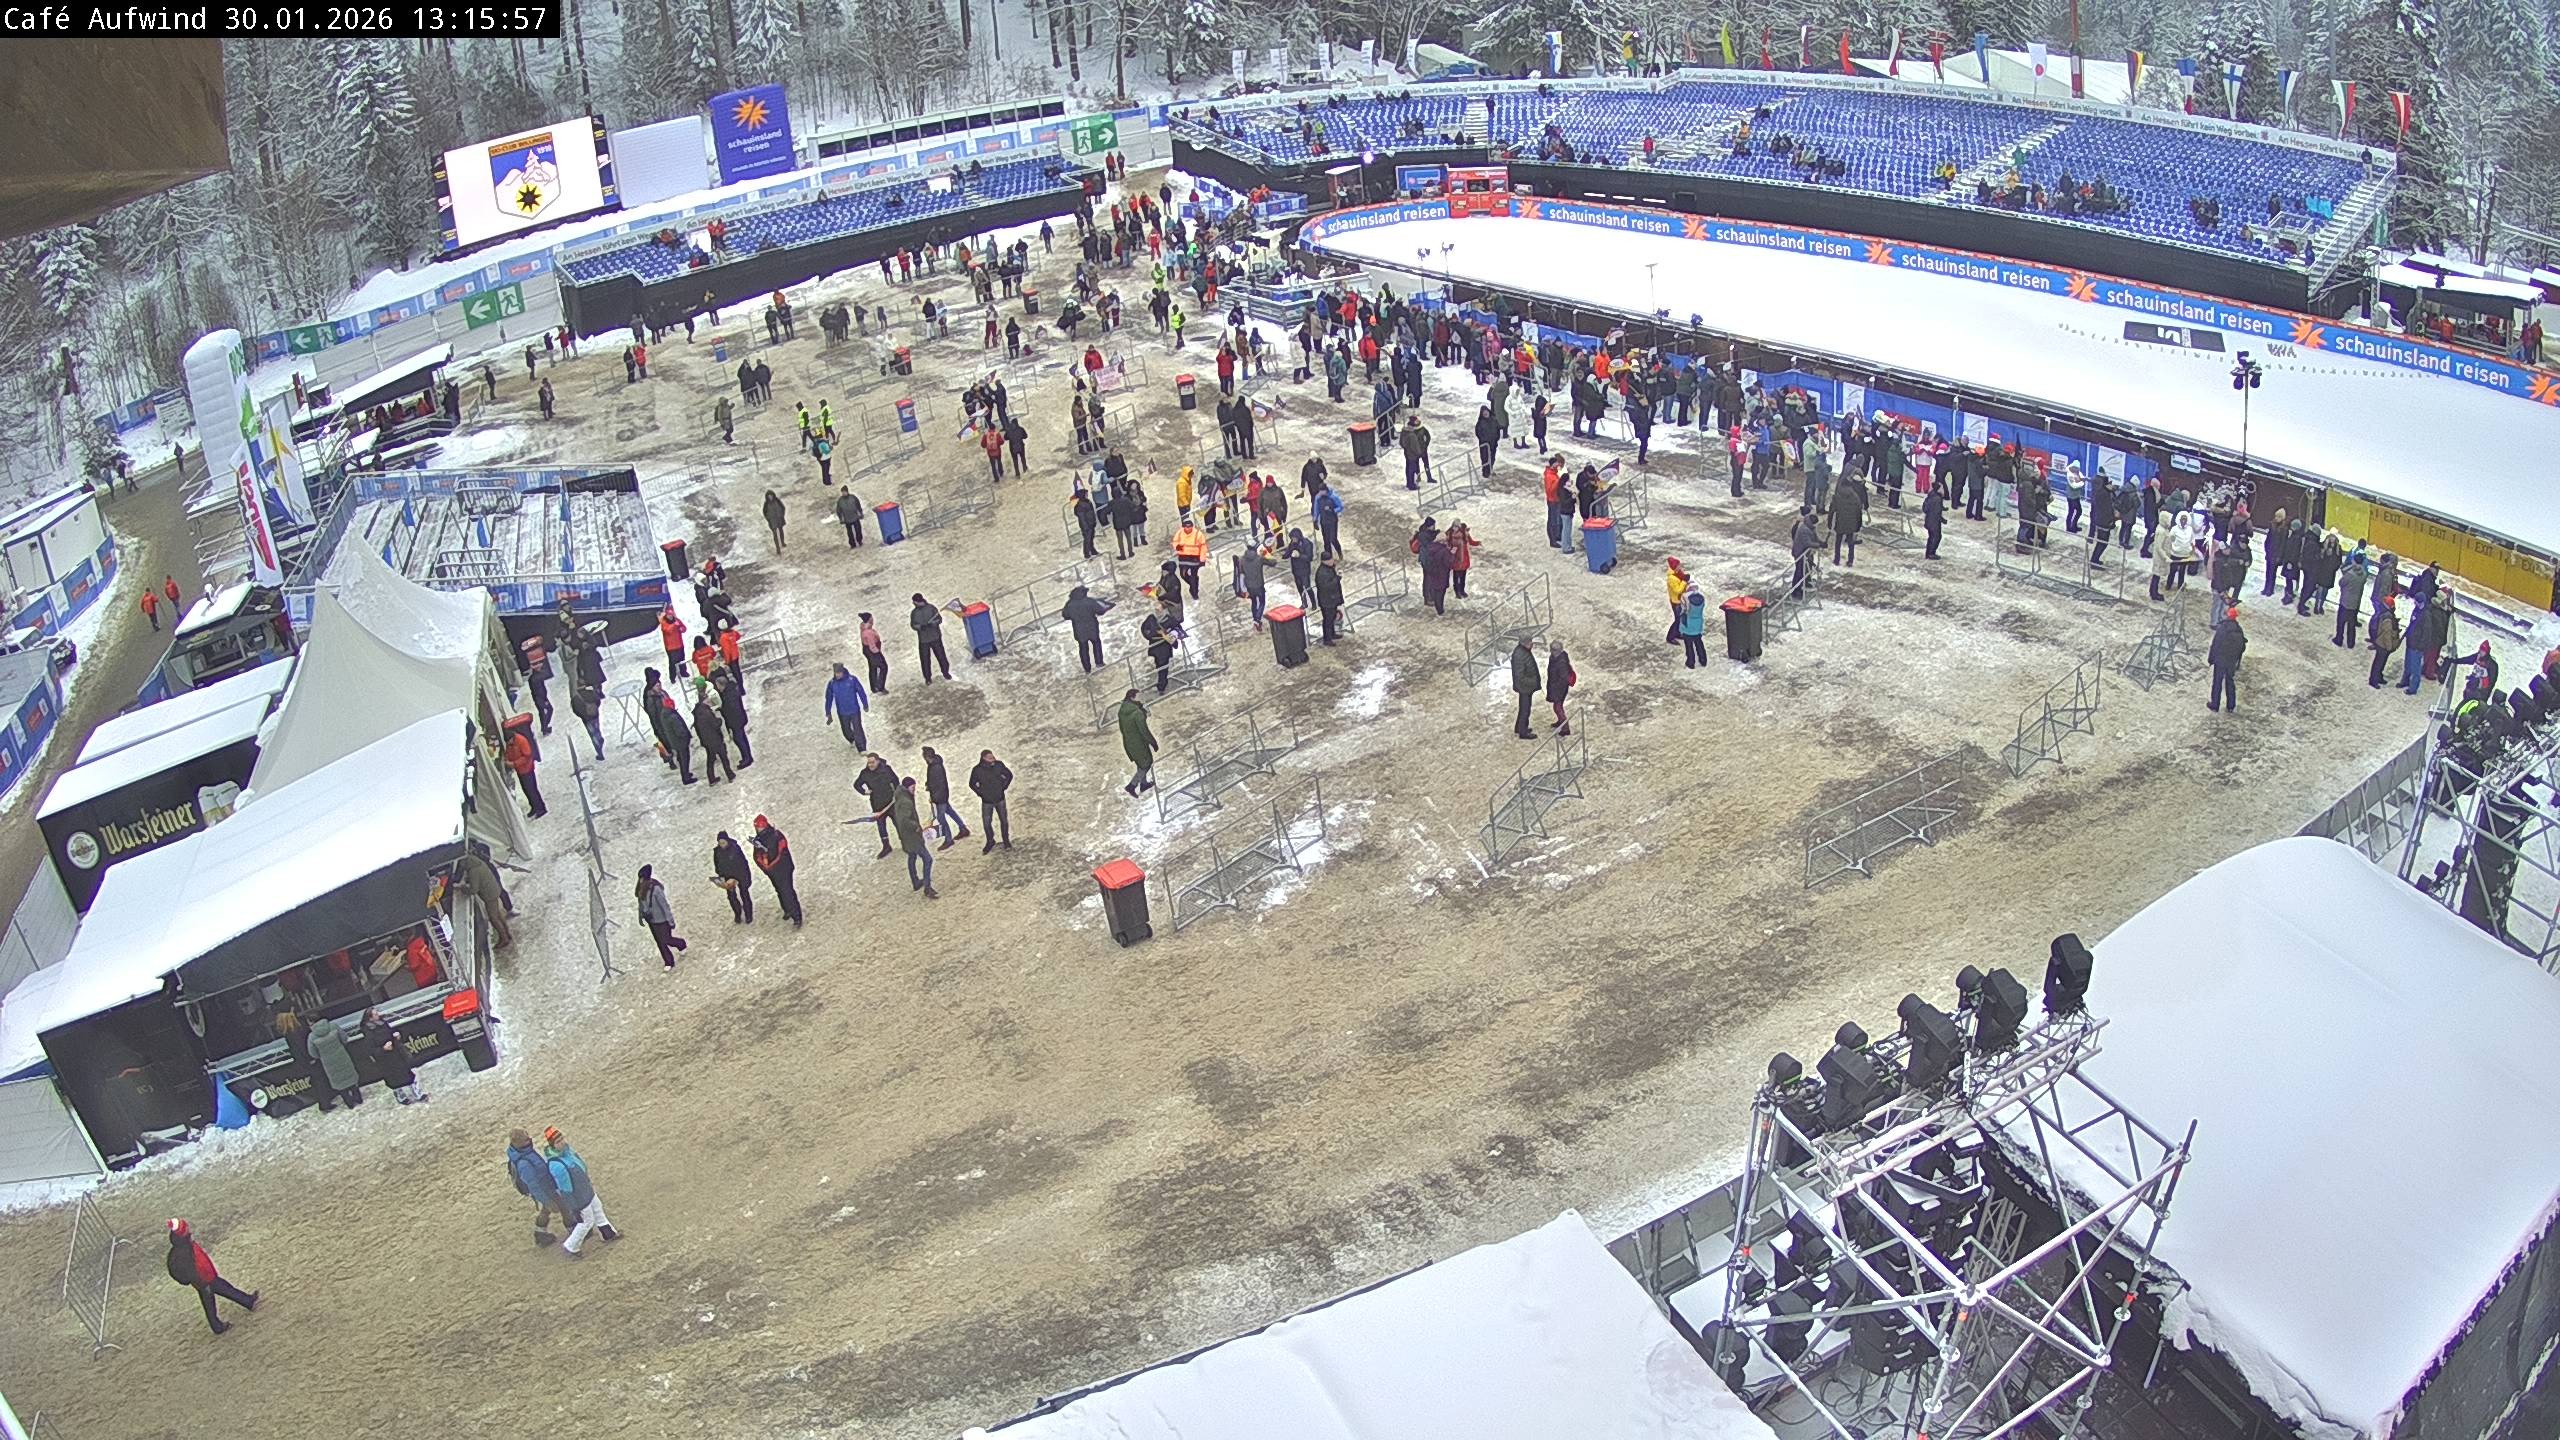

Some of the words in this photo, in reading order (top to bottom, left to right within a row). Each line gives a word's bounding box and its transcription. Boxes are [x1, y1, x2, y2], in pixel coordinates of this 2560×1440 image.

[2141, 113, 2151, 122] An
[2152, 115, 2180, 126] Hessen
[2181, 117, 2199, 129] führt
[2200, 121, 2216, 132] kein
[2216, 124, 2233, 136] Weg
[728, 129, 782, 149] schauinsland
[743, 142, 770, 153] reisen
[2278, 135, 2289, 146] An
[2290, 136, 2319, 150] Hessen
[1328, 208, 1400, 234] schauinsland
[1404, 206, 1445, 220] reisen
[1550, 206, 1628, 228] schauinsland
[1631, 217, 1670, 233] reisen
[562, 254, 573, 262] An
[574, 246, 602, 257] Hessen
[1716, 228, 1805, 250] schauinsland
[1809, 238, 1851, 257] reisen
[1902, 252, 1998, 281] schauinsland
[2002, 269, 2050, 290] reisen
[2107, 288, 2215, 323] schauinsland
[2219, 310, 2272, 335] reisen
[2336, 336, 2450, 373] schauinsland
[2455, 361, 2509, 388] reisen
[2384, 511, 2401, 525] EXIT
[2428, 526, 2446, 540] EXIT
[2475, 542, 2493, 558] EXIT
[99, 802, 196, 854] Warsteiner
[404, 1033, 439, 1053] steiner
[265, 1076, 312, 1100] Warsteine
